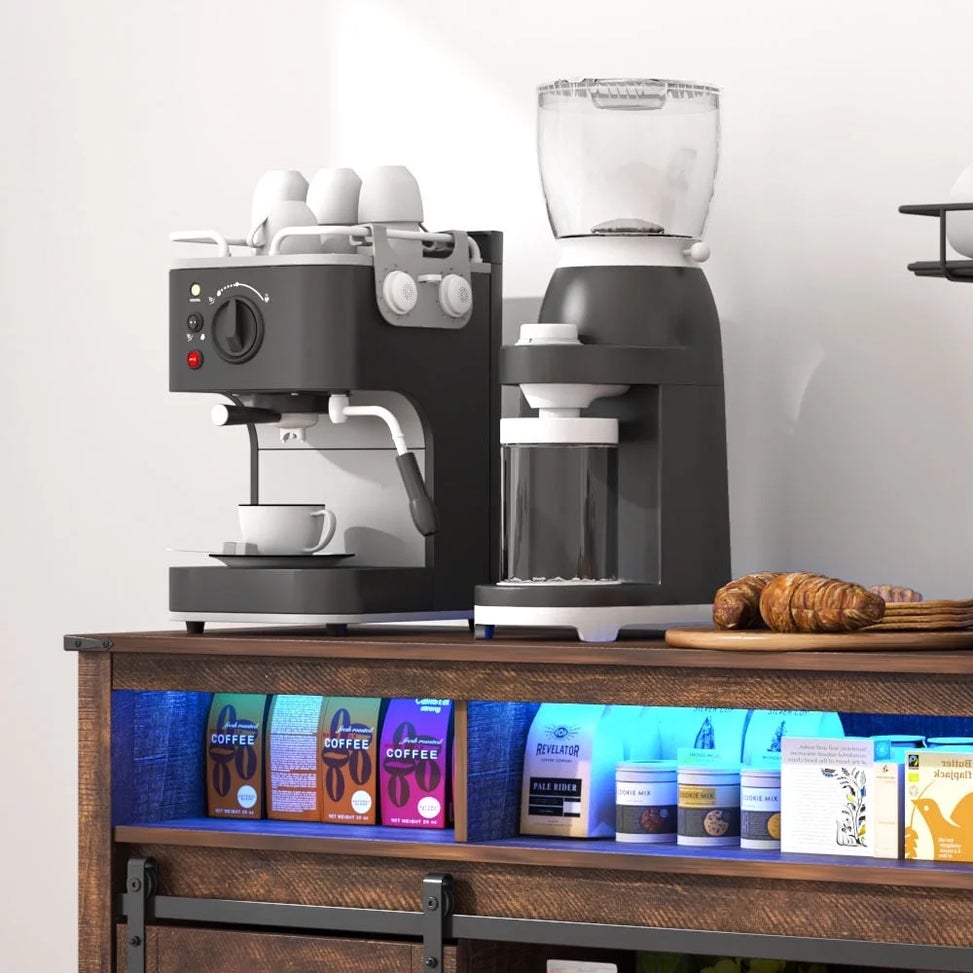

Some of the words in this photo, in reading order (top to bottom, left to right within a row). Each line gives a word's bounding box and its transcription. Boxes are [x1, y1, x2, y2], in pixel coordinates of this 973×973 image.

[211, 734, 255, 745] COFFEE
[324, 738, 370, 750] COFFEE
[386, 748, 438, 760] COFFEE
[536, 744, 580, 758] REVELATOR
[534, 782, 552, 790] PALE
[553, 783, 577, 792] RIDER
